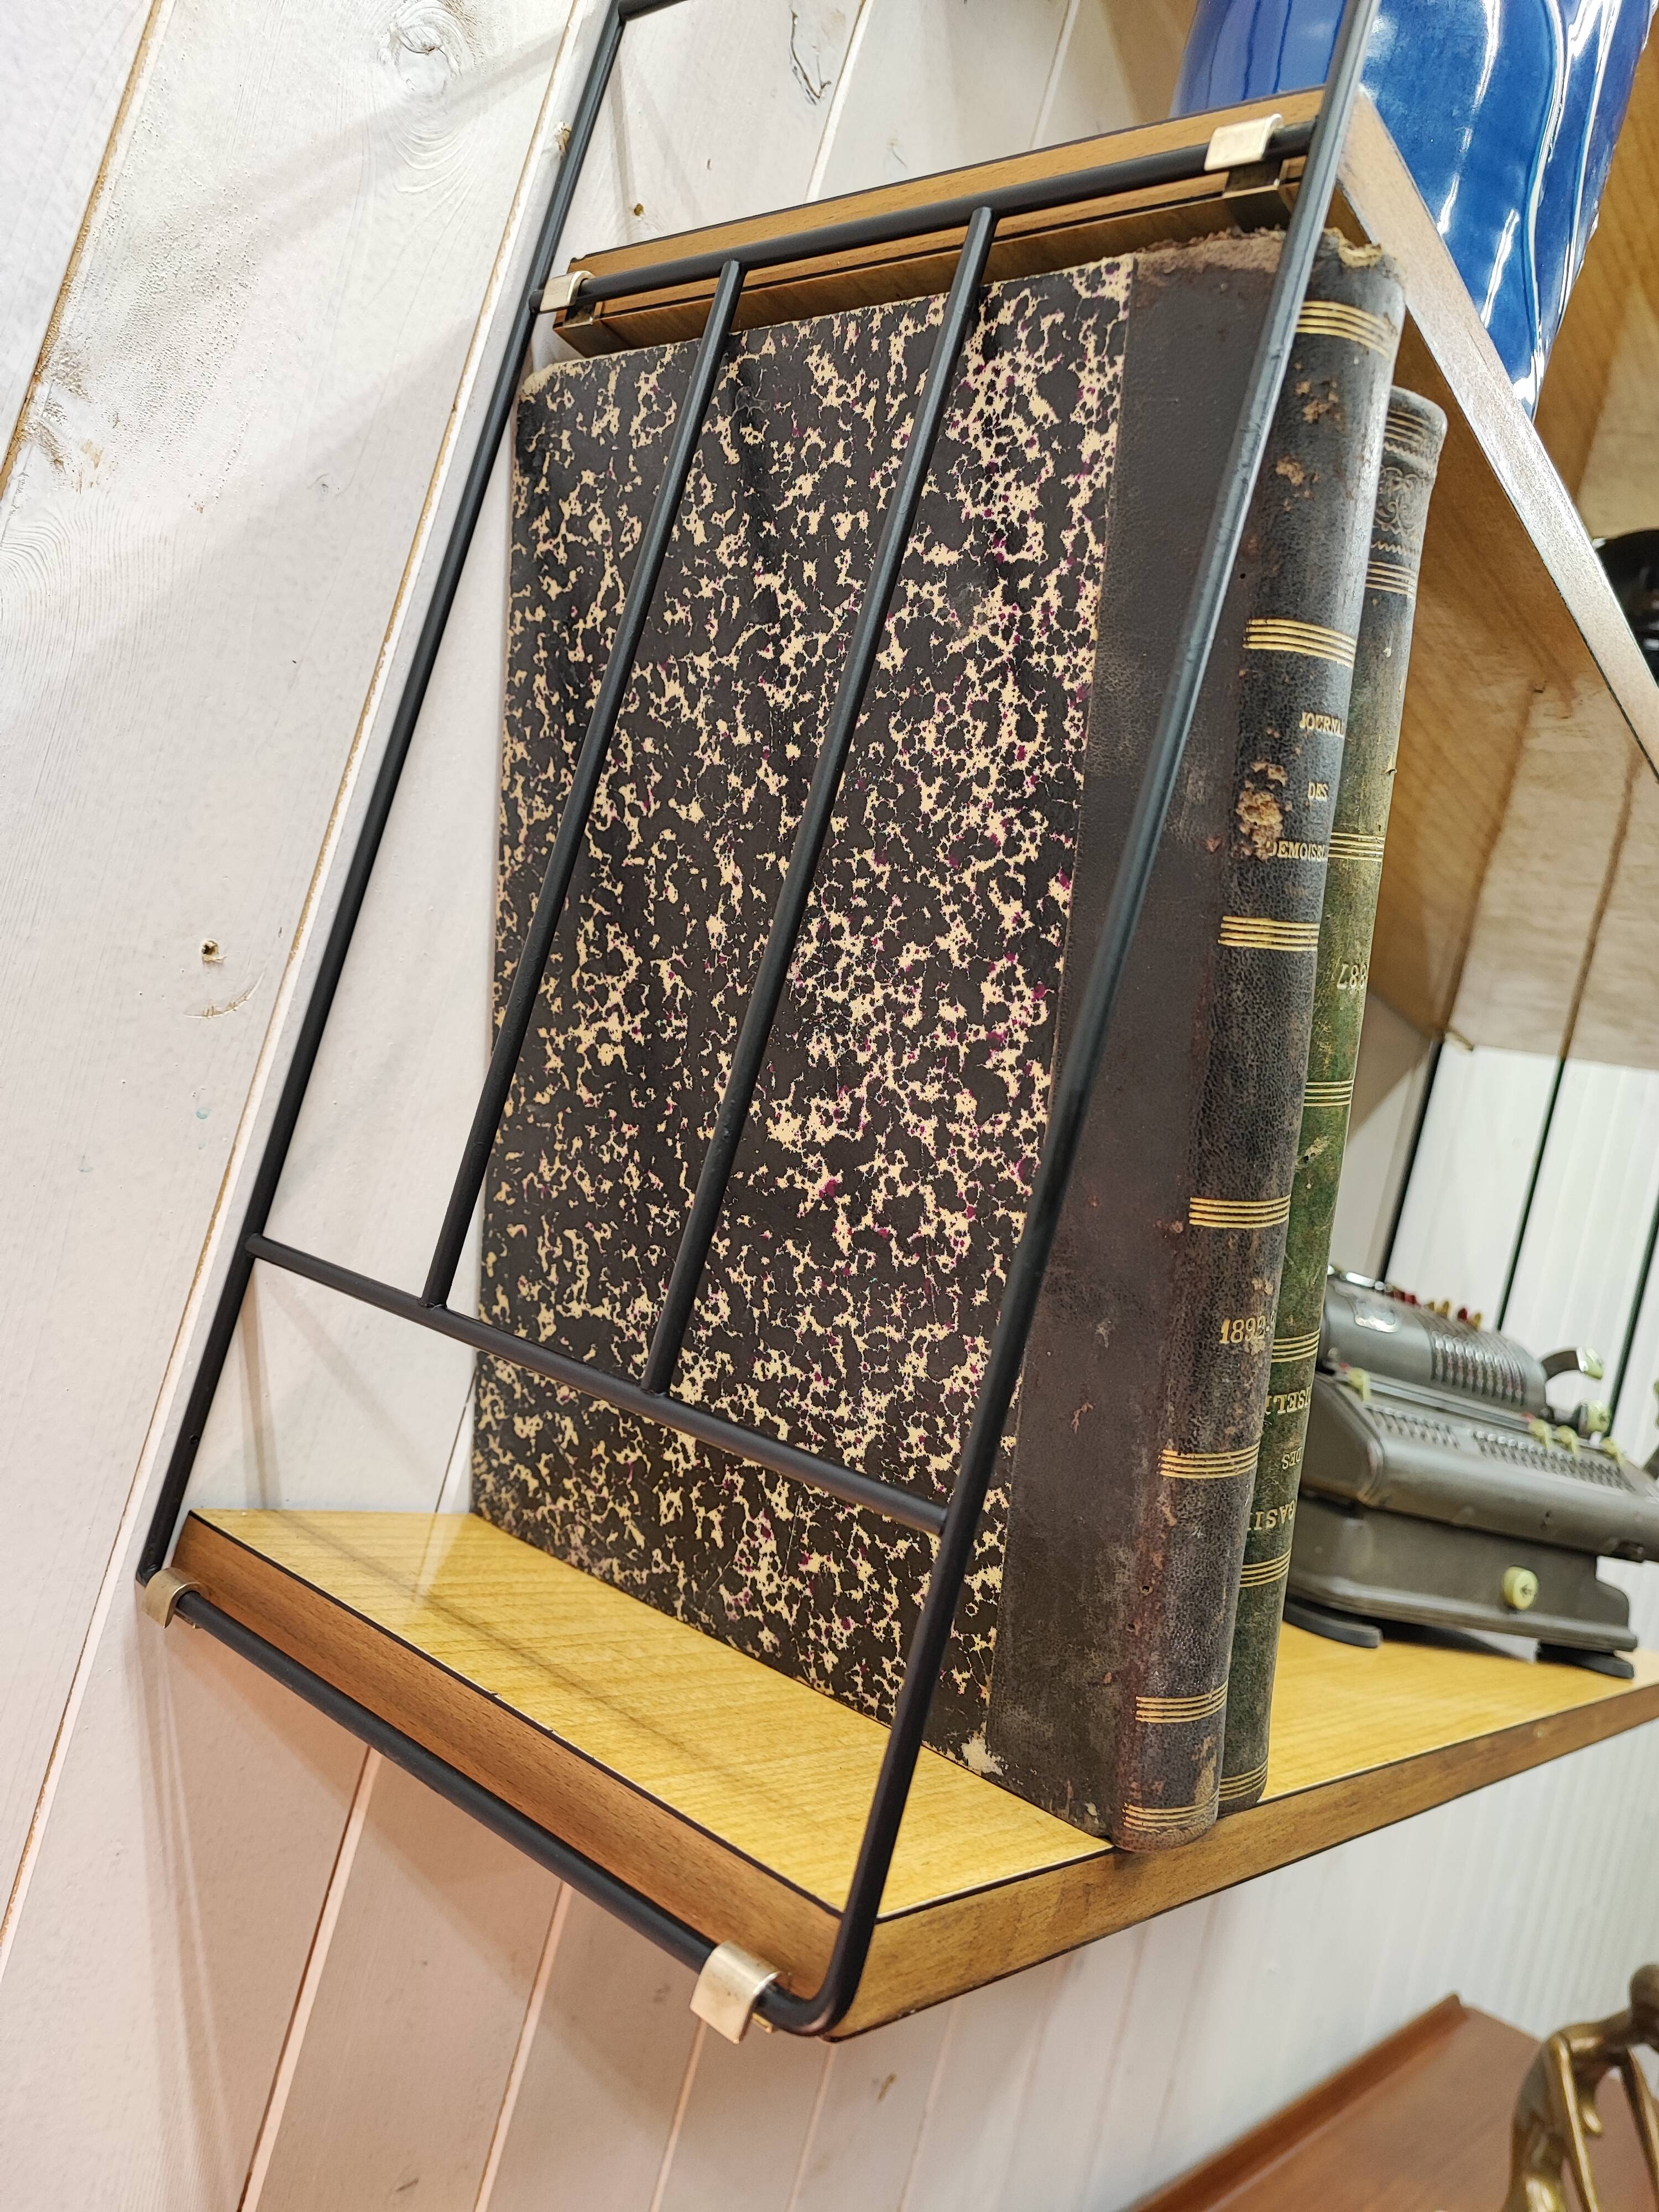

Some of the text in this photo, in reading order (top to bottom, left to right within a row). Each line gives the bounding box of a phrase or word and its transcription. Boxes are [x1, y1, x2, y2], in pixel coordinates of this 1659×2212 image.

[1307, 781, 1329, 802] DES
[1281, 1446, 1302, 1470] DES
[1248, 1499, 1295, 1531] GASI
